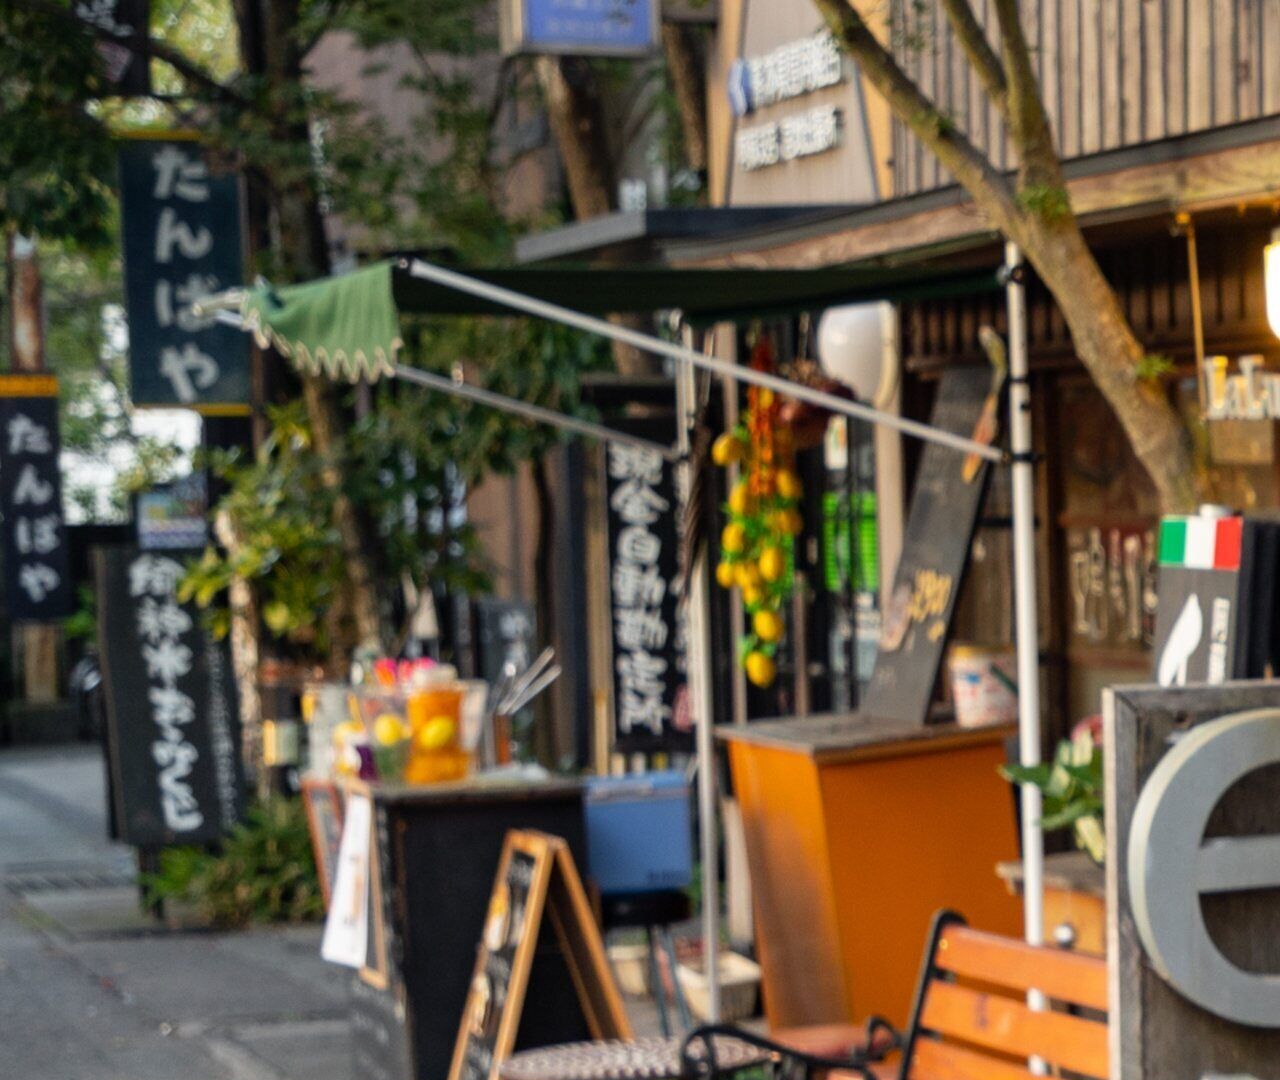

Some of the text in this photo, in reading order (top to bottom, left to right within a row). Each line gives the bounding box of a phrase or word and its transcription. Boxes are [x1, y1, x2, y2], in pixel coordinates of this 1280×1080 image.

[152, 146, 220, 403] たんばや
[8, 413, 61, 602] たんばや
